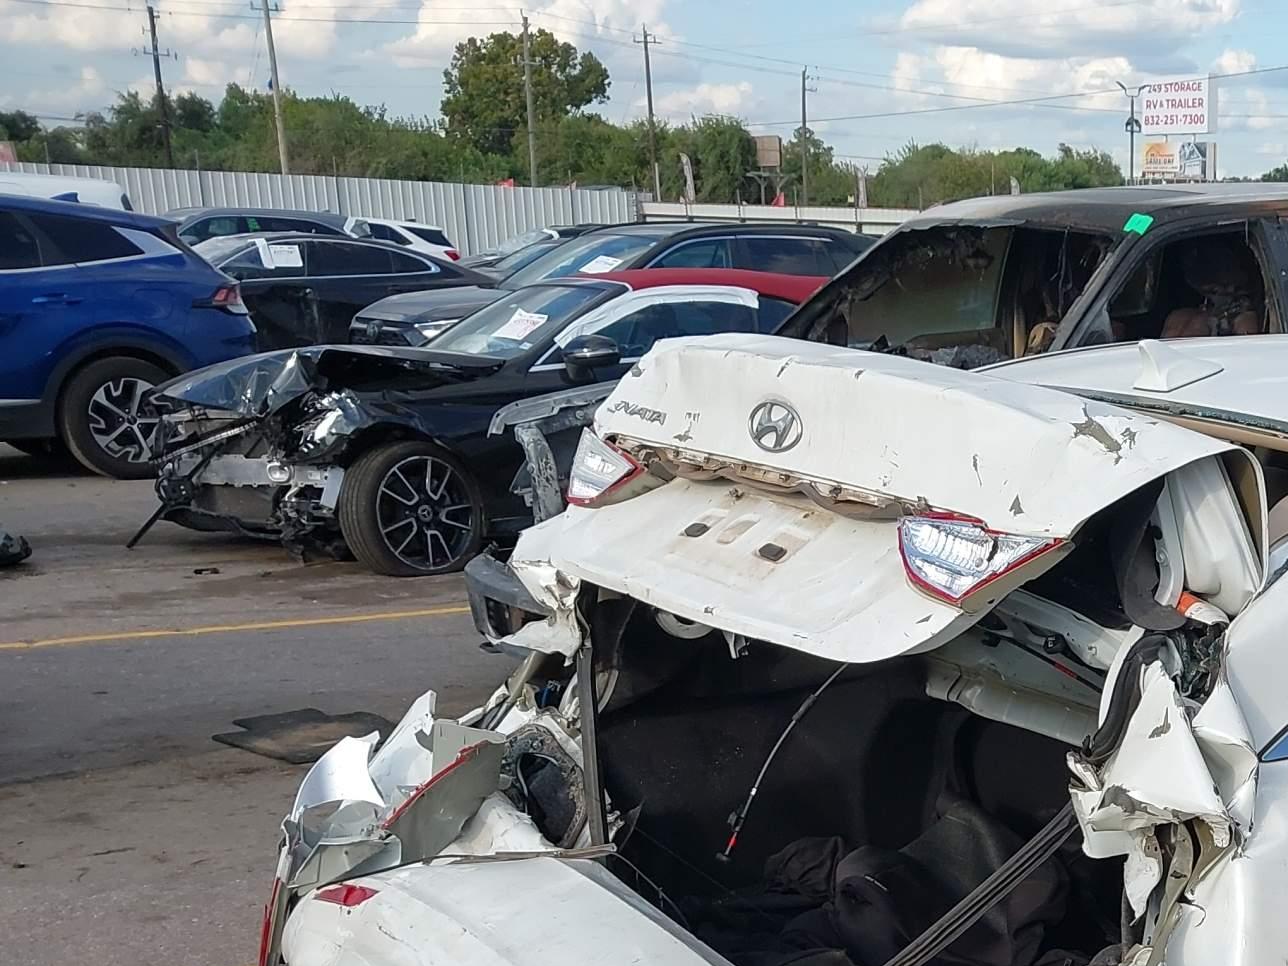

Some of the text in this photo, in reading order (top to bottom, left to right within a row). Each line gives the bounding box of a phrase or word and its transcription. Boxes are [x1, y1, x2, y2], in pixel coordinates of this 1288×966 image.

[1148, 82, 1203, 93] 249 STORAGE
[1146, 99, 1158, 110] RV
[1165, 98, 1204, 109] TRAILER
[1144, 113, 1205, 125] 832-251-7300
